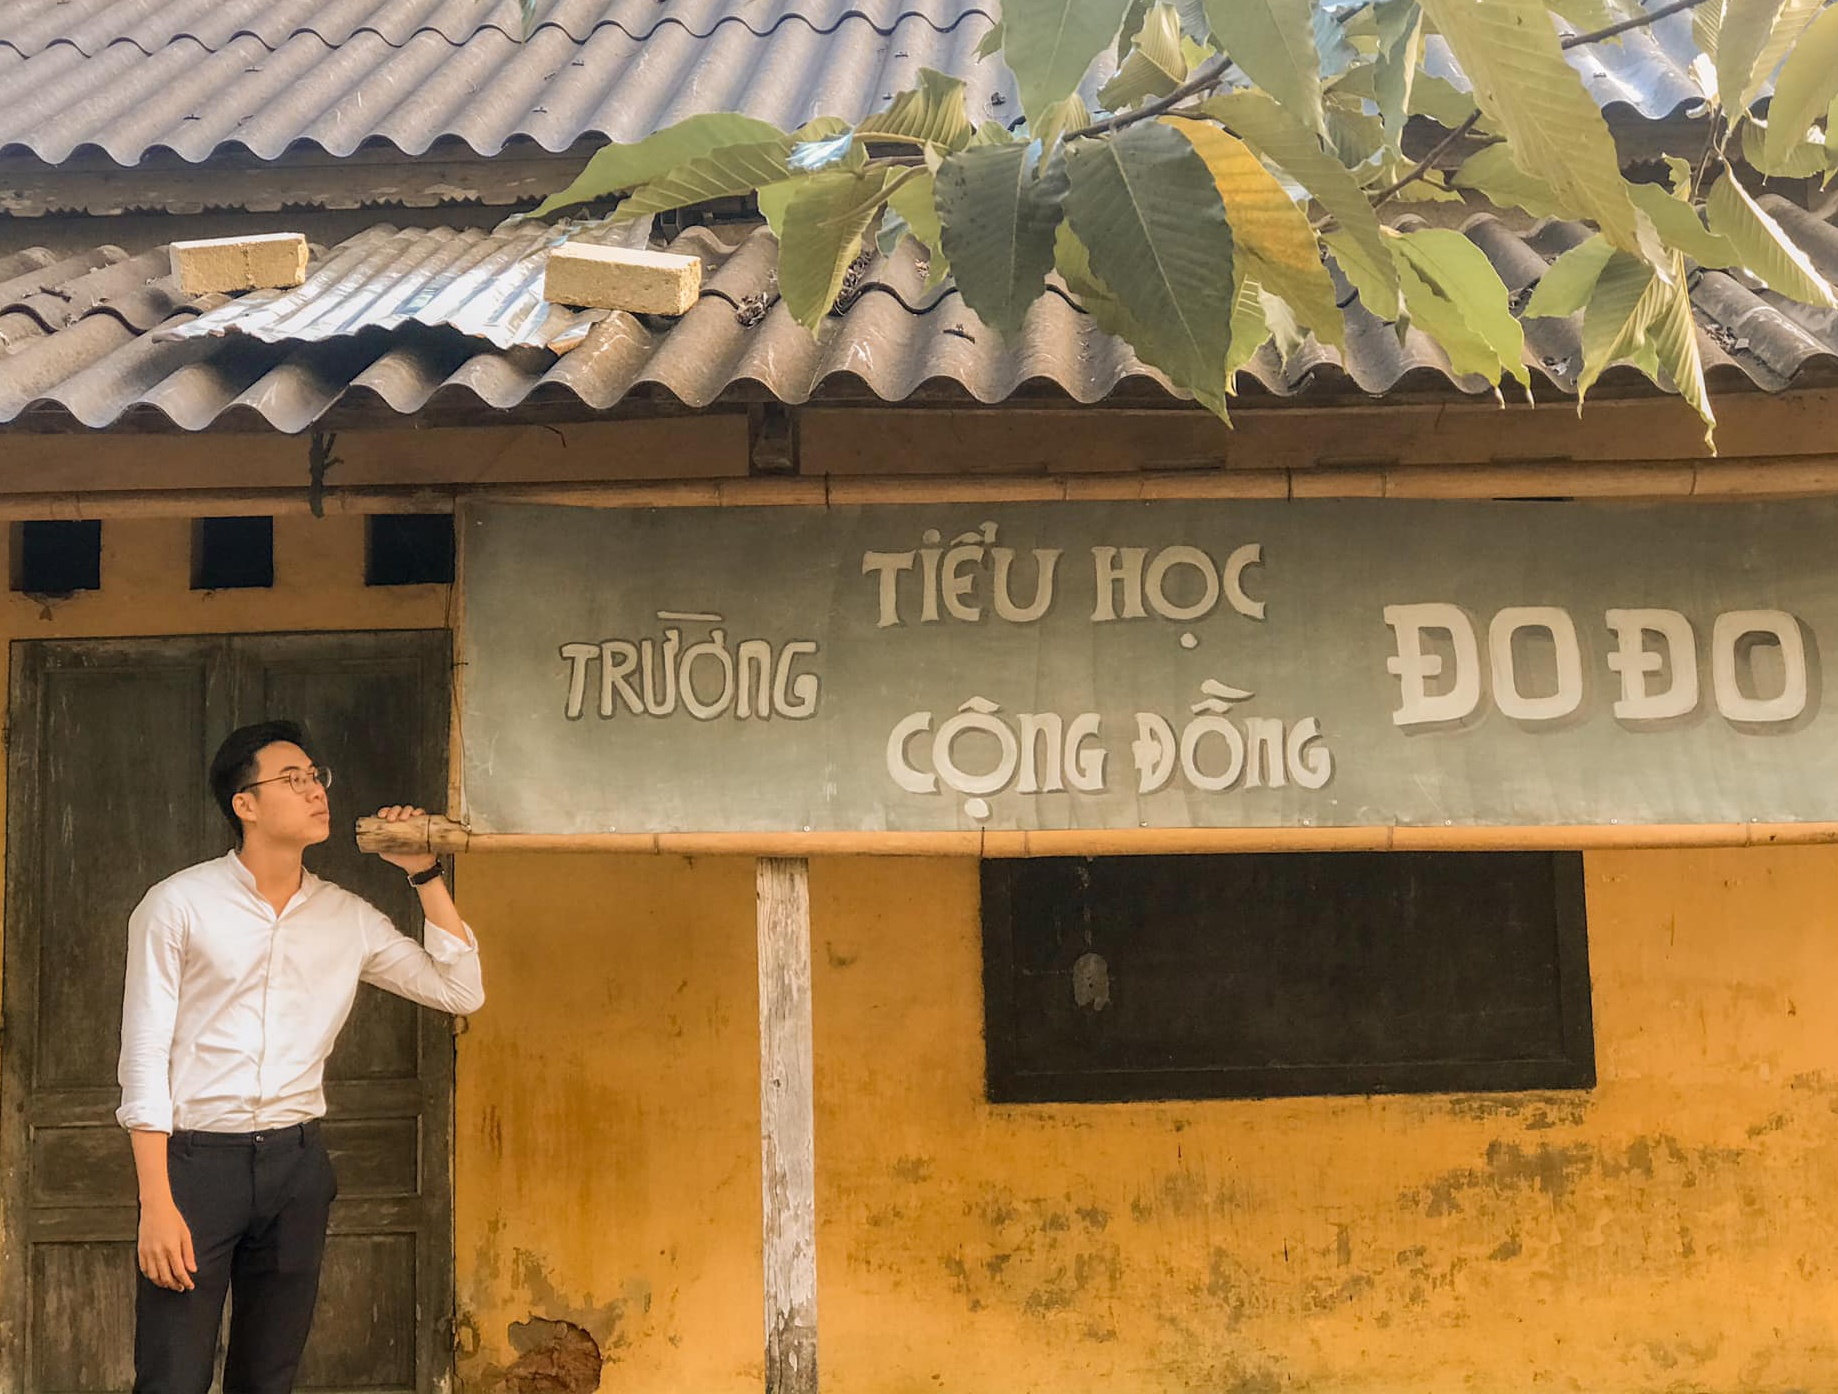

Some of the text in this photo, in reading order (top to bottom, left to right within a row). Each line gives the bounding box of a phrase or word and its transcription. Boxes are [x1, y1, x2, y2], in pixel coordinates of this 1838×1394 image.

[862, 521, 1266, 649] TIỂU HỌC
[561, 611, 818, 719] TRƯỜNG
[1383, 602, 1808, 726] ĐO ĐO
[887, 679, 1333, 818] CỘNG ĐỒNG
